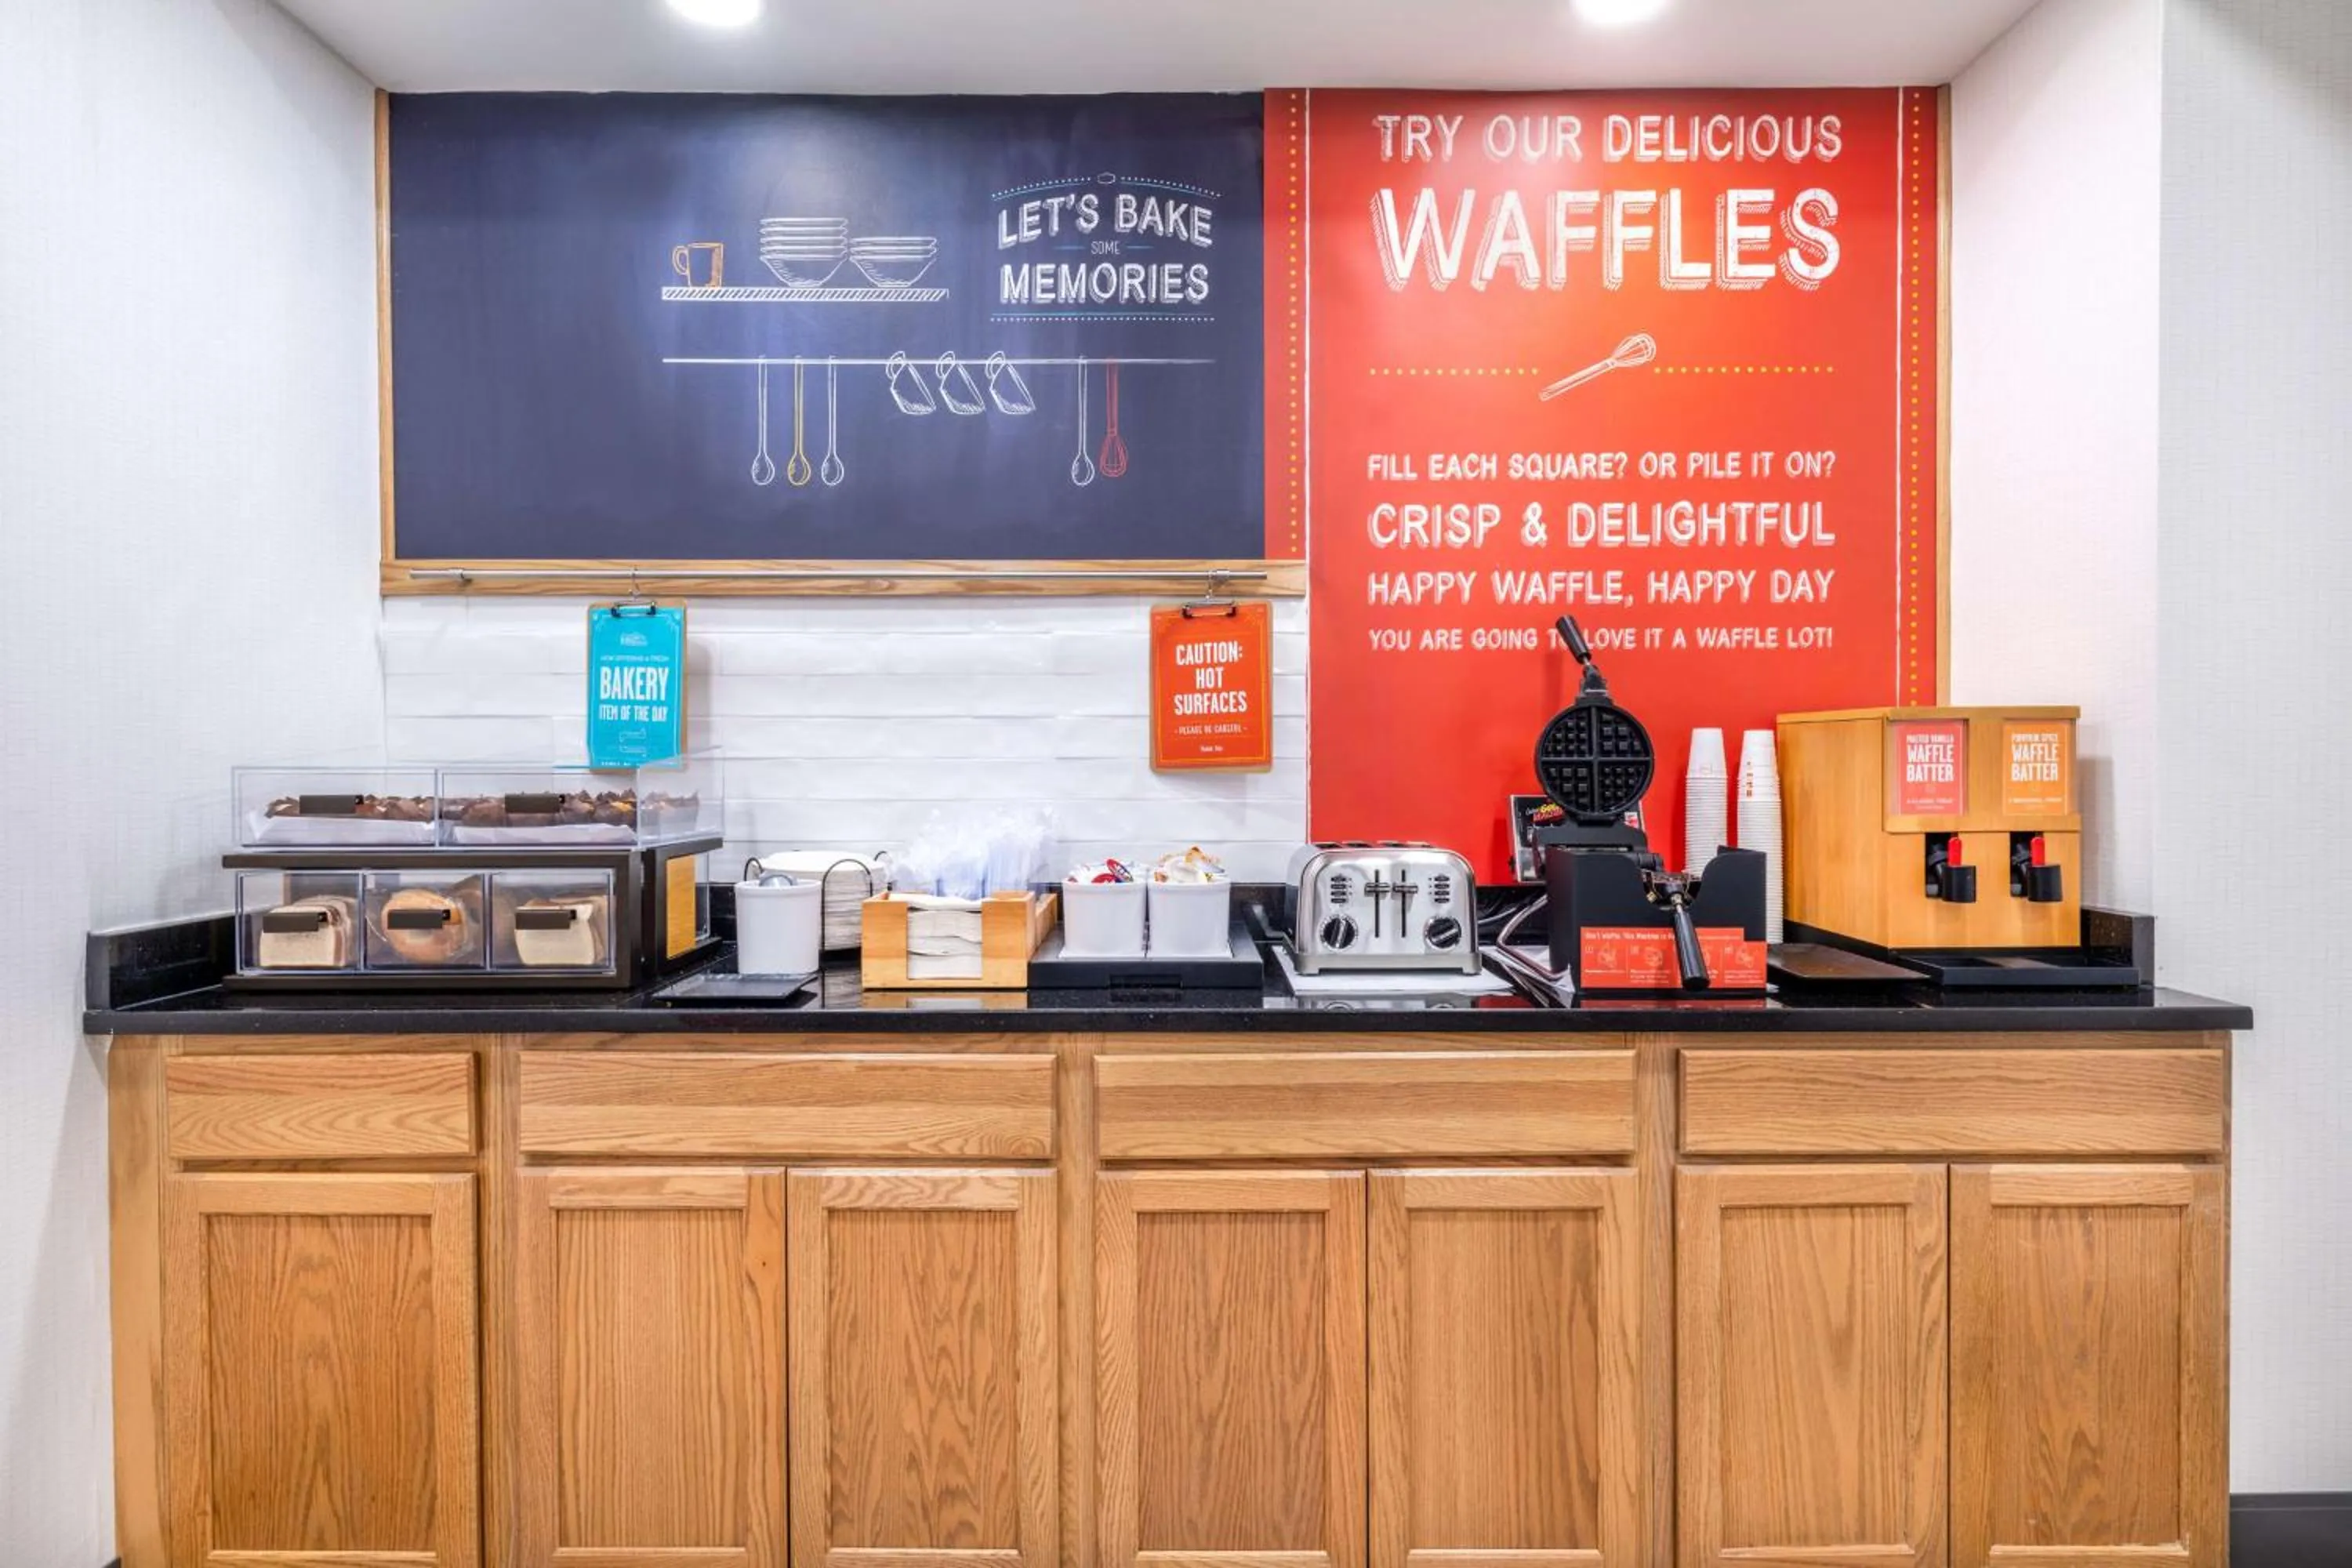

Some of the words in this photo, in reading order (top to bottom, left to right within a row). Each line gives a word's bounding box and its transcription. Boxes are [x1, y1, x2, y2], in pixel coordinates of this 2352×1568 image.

[1372, 114, 1463, 162] TRY
[1483, 115, 1582, 162] OUR
[1602, 114, 1842, 162] DELICIOUS
[998, 193, 1098, 249] LET'S
[1114, 193, 1213, 249] BAKE
[1091, 241, 1120, 255] SOME
[1369, 187, 1841, 292] WAFFLES
[1000, 262, 1210, 304] MEMORIES
[1367, 454, 1417, 481] FILL
[1428, 453, 1497, 480] EACH
[1508, 452, 1628, 480] SQUARE?
[1639, 452, 1676, 479] OR
[1686, 452, 1740, 478] PILE
[1751, 452, 1774, 477] IT
[1785, 451, 1836, 478] ON?
[1367, 503, 1501, 548] CRISP
[1520, 502, 1548, 544] &
[1567, 500, 1835, 547] DELIGHTFUL
[1368, 572, 1477, 605] HAPPY
[1490, 570, 1635, 608] WAFFLE,
[1647, 568, 1757, 604] HAPPY
[1769, 568, 1835, 603] DAY
[1369, 628, 1411, 651] YOU
[1419, 628, 1464, 651] ARE
[1471, 627, 1538, 650] GOING
[1547, 627, 1568, 650] T
[1582, 627, 1636, 650] LOVE
[1644, 627, 1662, 649] IT
[1671, 627, 1686, 649] A
[1696, 627, 1777, 649] WAFFLE
[1786, 626, 1834, 648] LOT!
[1176, 641, 1243, 665] CAUTION:
[600, 666, 670, 701] BAKERY
[1196, 667, 1225, 690] HOT
[599, 704, 619, 720] ITEM
[620, 705, 630, 721] OF
[633, 705, 649, 722] THE
[652, 706, 669, 722] DAY
[1174, 691, 1247, 715] SURFACES
[1907, 744, 1955, 762] WAFFLE
[2011, 743, 2059, 761] WAFFLE
[1907, 764, 1955, 782] BATTER
[2011, 763, 2058, 781] BATTER
